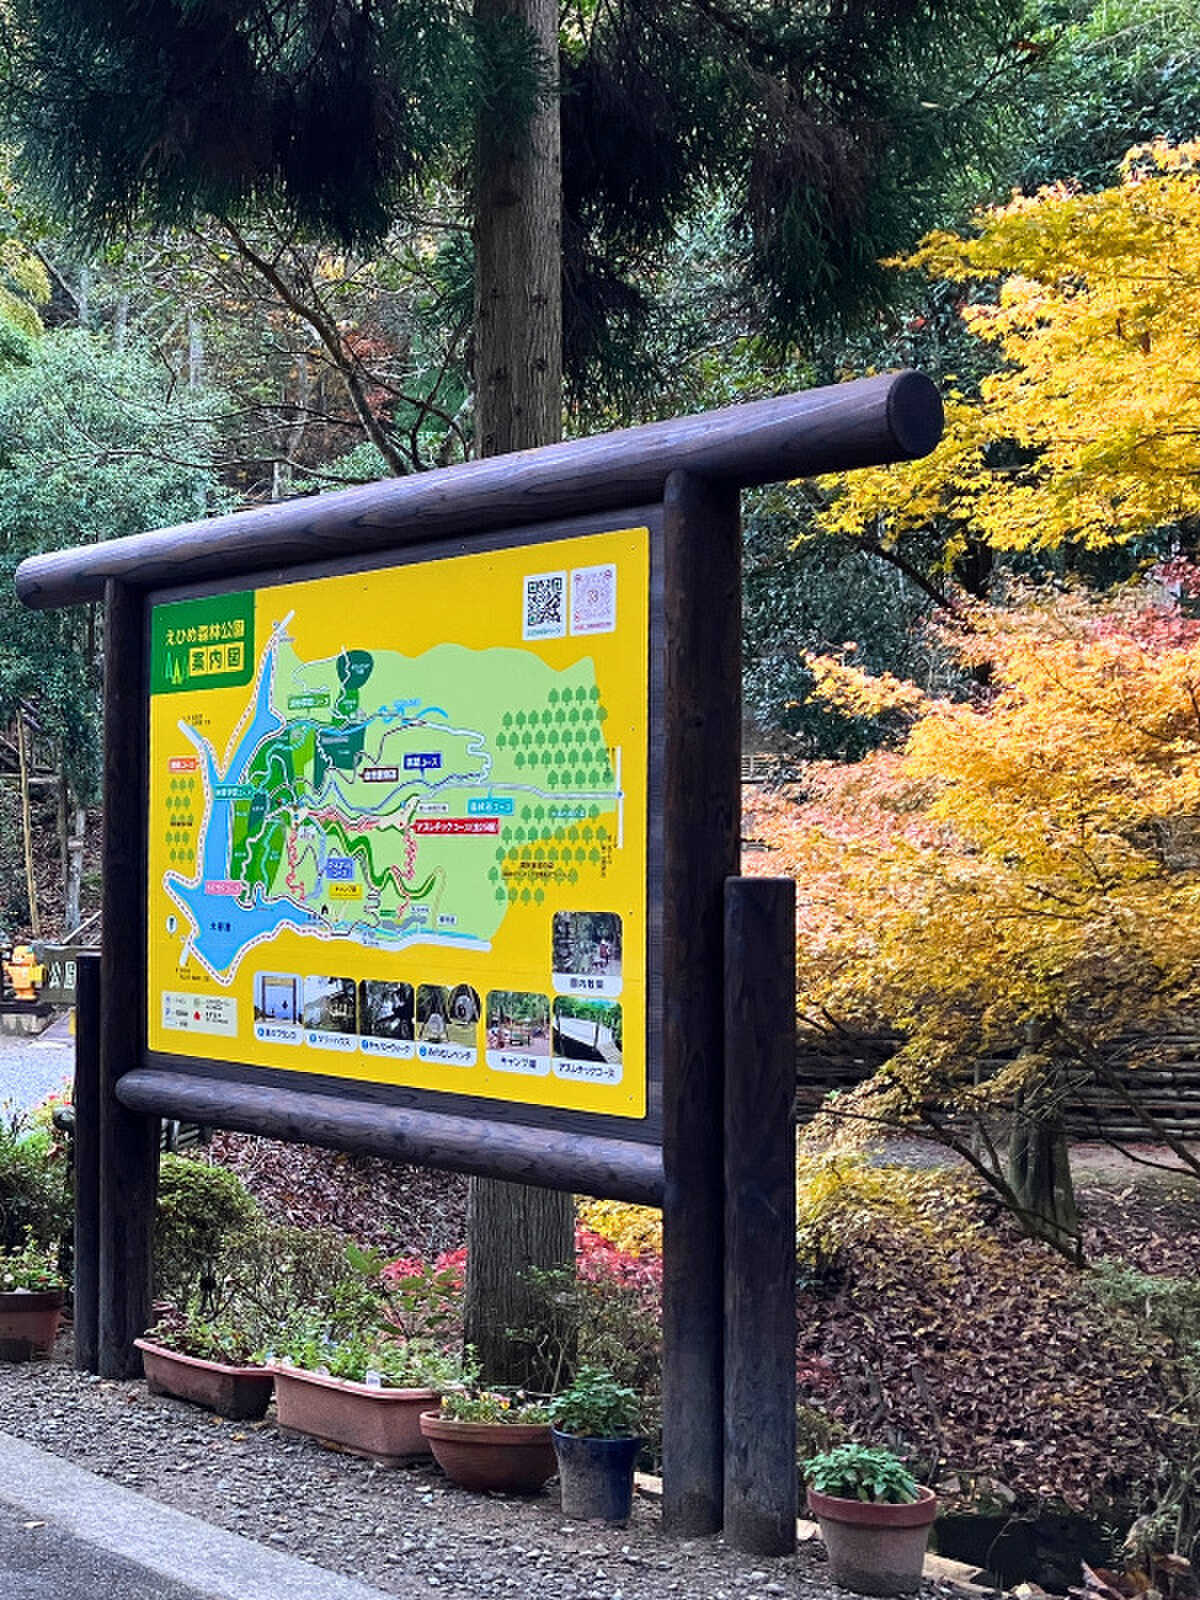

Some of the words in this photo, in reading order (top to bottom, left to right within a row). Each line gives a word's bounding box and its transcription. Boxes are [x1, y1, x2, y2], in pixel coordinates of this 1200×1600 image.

[165, 619, 245, 646] えひめ森林公園
[191, 645, 242, 673] 案内図
